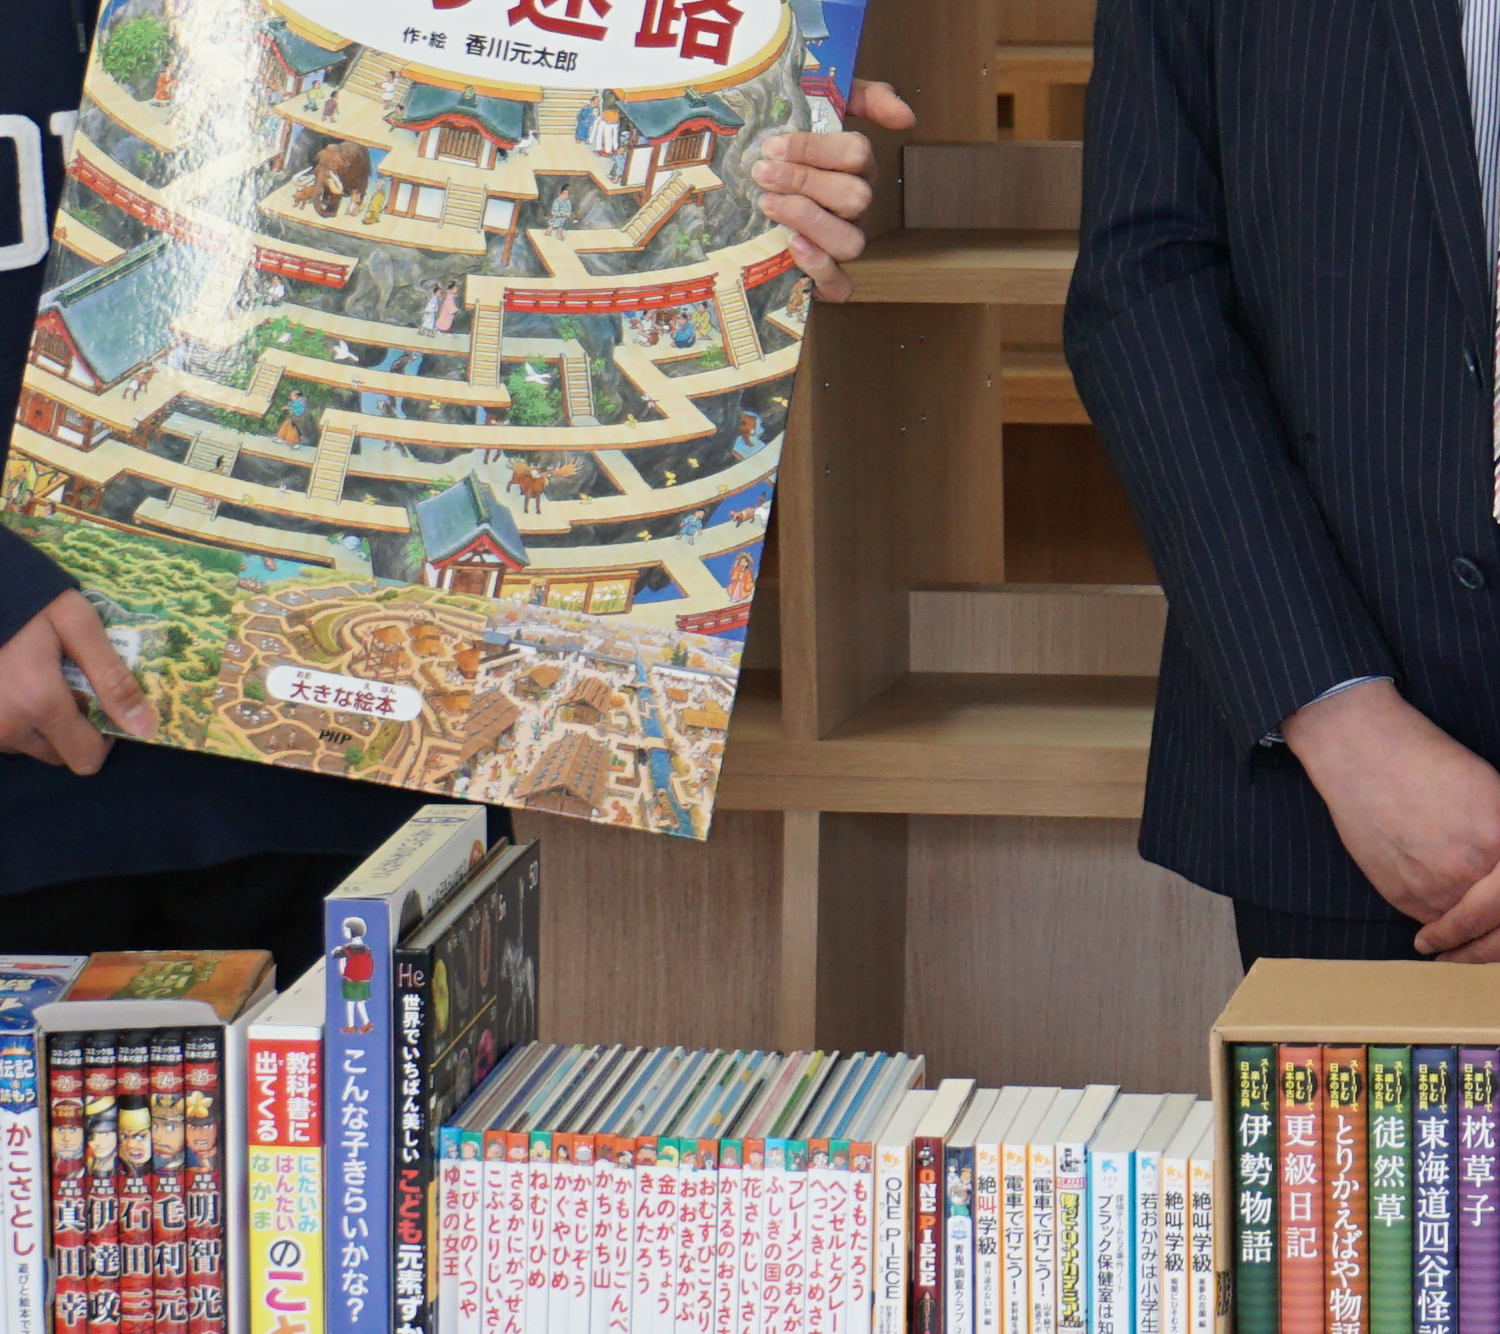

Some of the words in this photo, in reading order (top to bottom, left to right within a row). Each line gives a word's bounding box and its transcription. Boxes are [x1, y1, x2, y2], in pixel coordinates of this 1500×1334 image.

[402, 27, 449, 50] 作・絵
[465, 33, 579, 72] 香川元太郎
[290, 680, 398, 715] 大きな絵本
[255, 1050, 280, 1143] 出てくる
[285, 1050, 312, 1143] 教科書に
[401, 992, 426, 1164] 世界でいちばん美しい
[6, 1122, 37, 1257] かこさとし
[251, 1153, 274, 1230] なかま
[340, 1048, 371, 1323] こんな子きらいかな?
[443, 1168, 461, 1279] ゆきの女王
[528, 1170, 550, 1290] ねむりひめ
[551, 1172, 573, 1293] かぐやひめ
[594, 1169, 615, 1291] かちかち山
[636, 1172, 657, 1295] きんたろう
[918, 1169, 938, 1212] ONE
[977, 1174, 998, 1256] 絶叫学級
[1164, 1190, 1184, 1273] 絶叫学級
[1191, 1190, 1212, 1273] 絶叫学級
[1238, 1113, 1274, 1264] 伊勢物語
[1283, 1113, 1318, 1259] 更級日記
[1372, 1117, 1408, 1229] 徒然草
[1461, 1117, 1497, 1229] 枕草子
[459, 1168, 478, 1319] こびとのくつや
[571, 1175, 594, 1299] かさじぞう
[656, 1173, 678, 1316] 金のがちょう
[677, 1178, 698, 1324] おおきなかぶ
[850, 1180, 870, 1303] ももたろう
[1004, 1174, 1025, 1295] 電車で行こう!
[1033, 1176, 1054, 1298] 電車で行こう!
